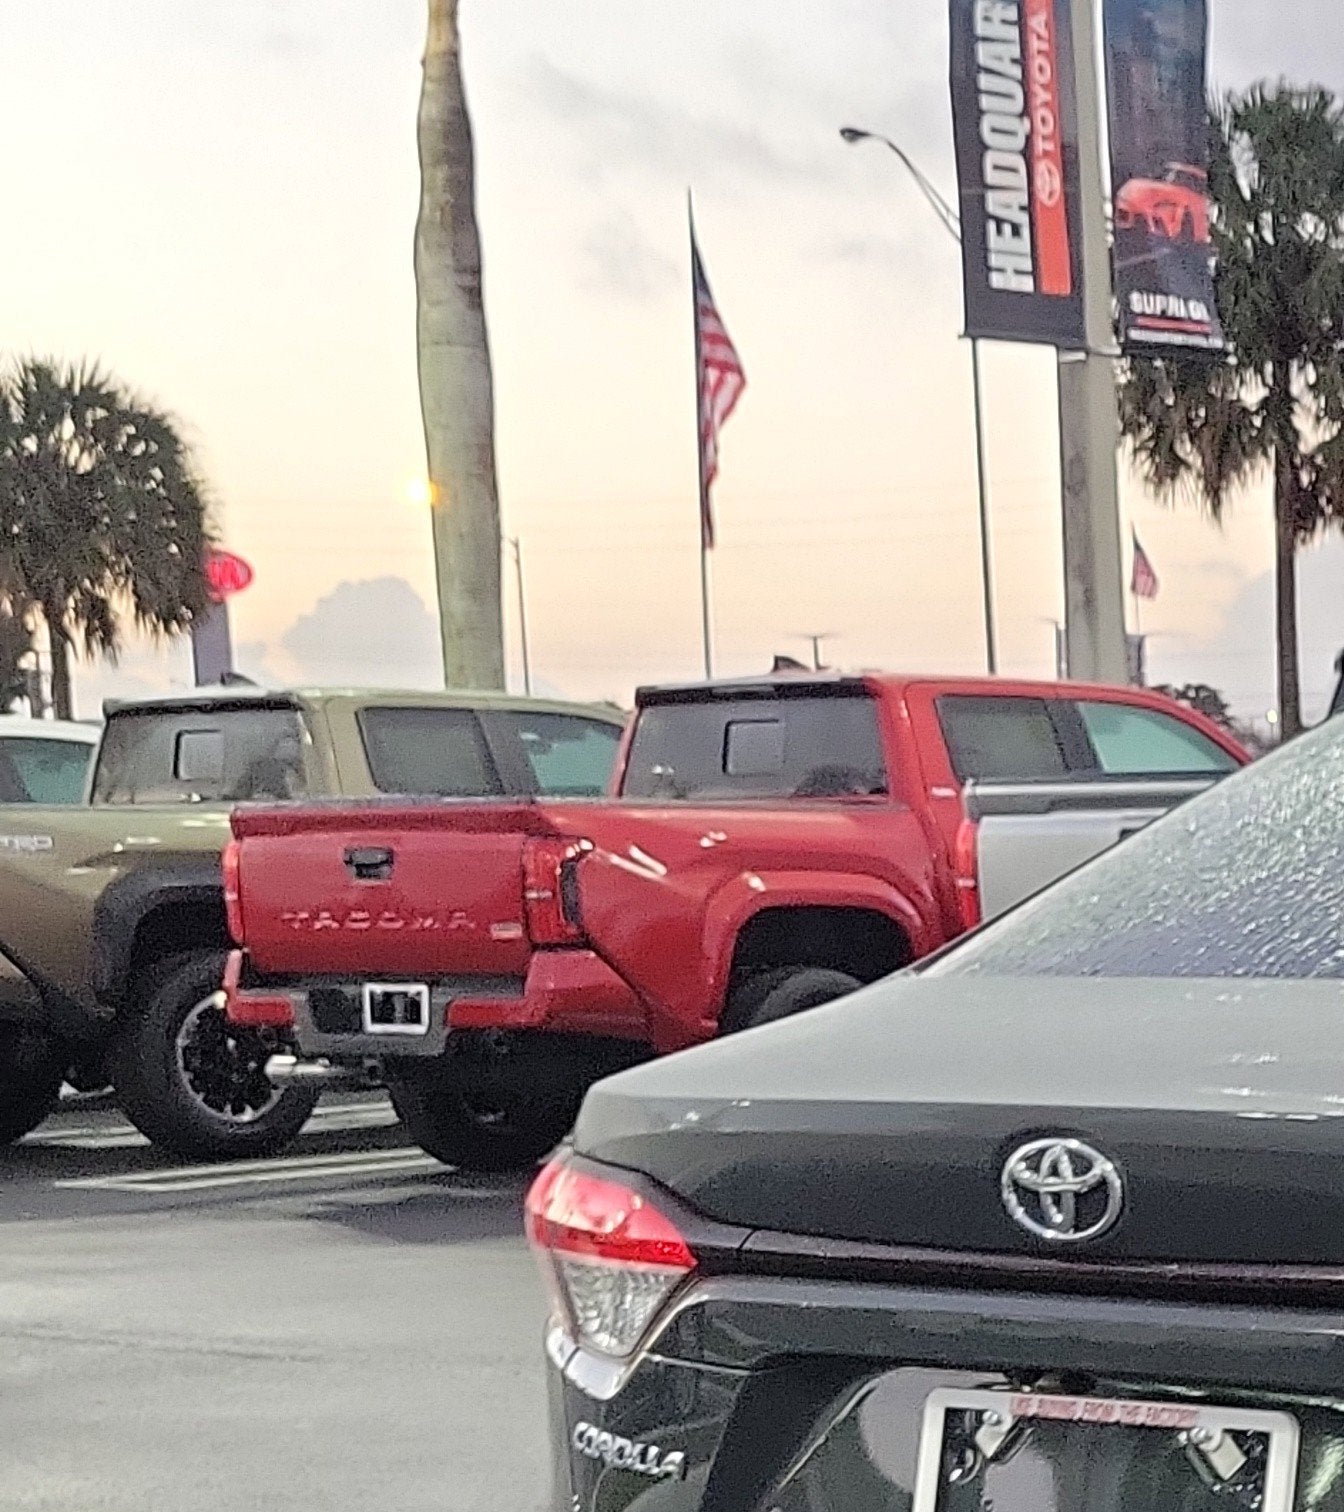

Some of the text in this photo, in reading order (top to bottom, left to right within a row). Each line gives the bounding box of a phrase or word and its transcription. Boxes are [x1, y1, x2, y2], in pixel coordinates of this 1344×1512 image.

[1027, 10, 1056, 157] TOYOTA
[281, 910, 476, 930] TACOMA
[573, 1421, 685, 1479] COROLLA
